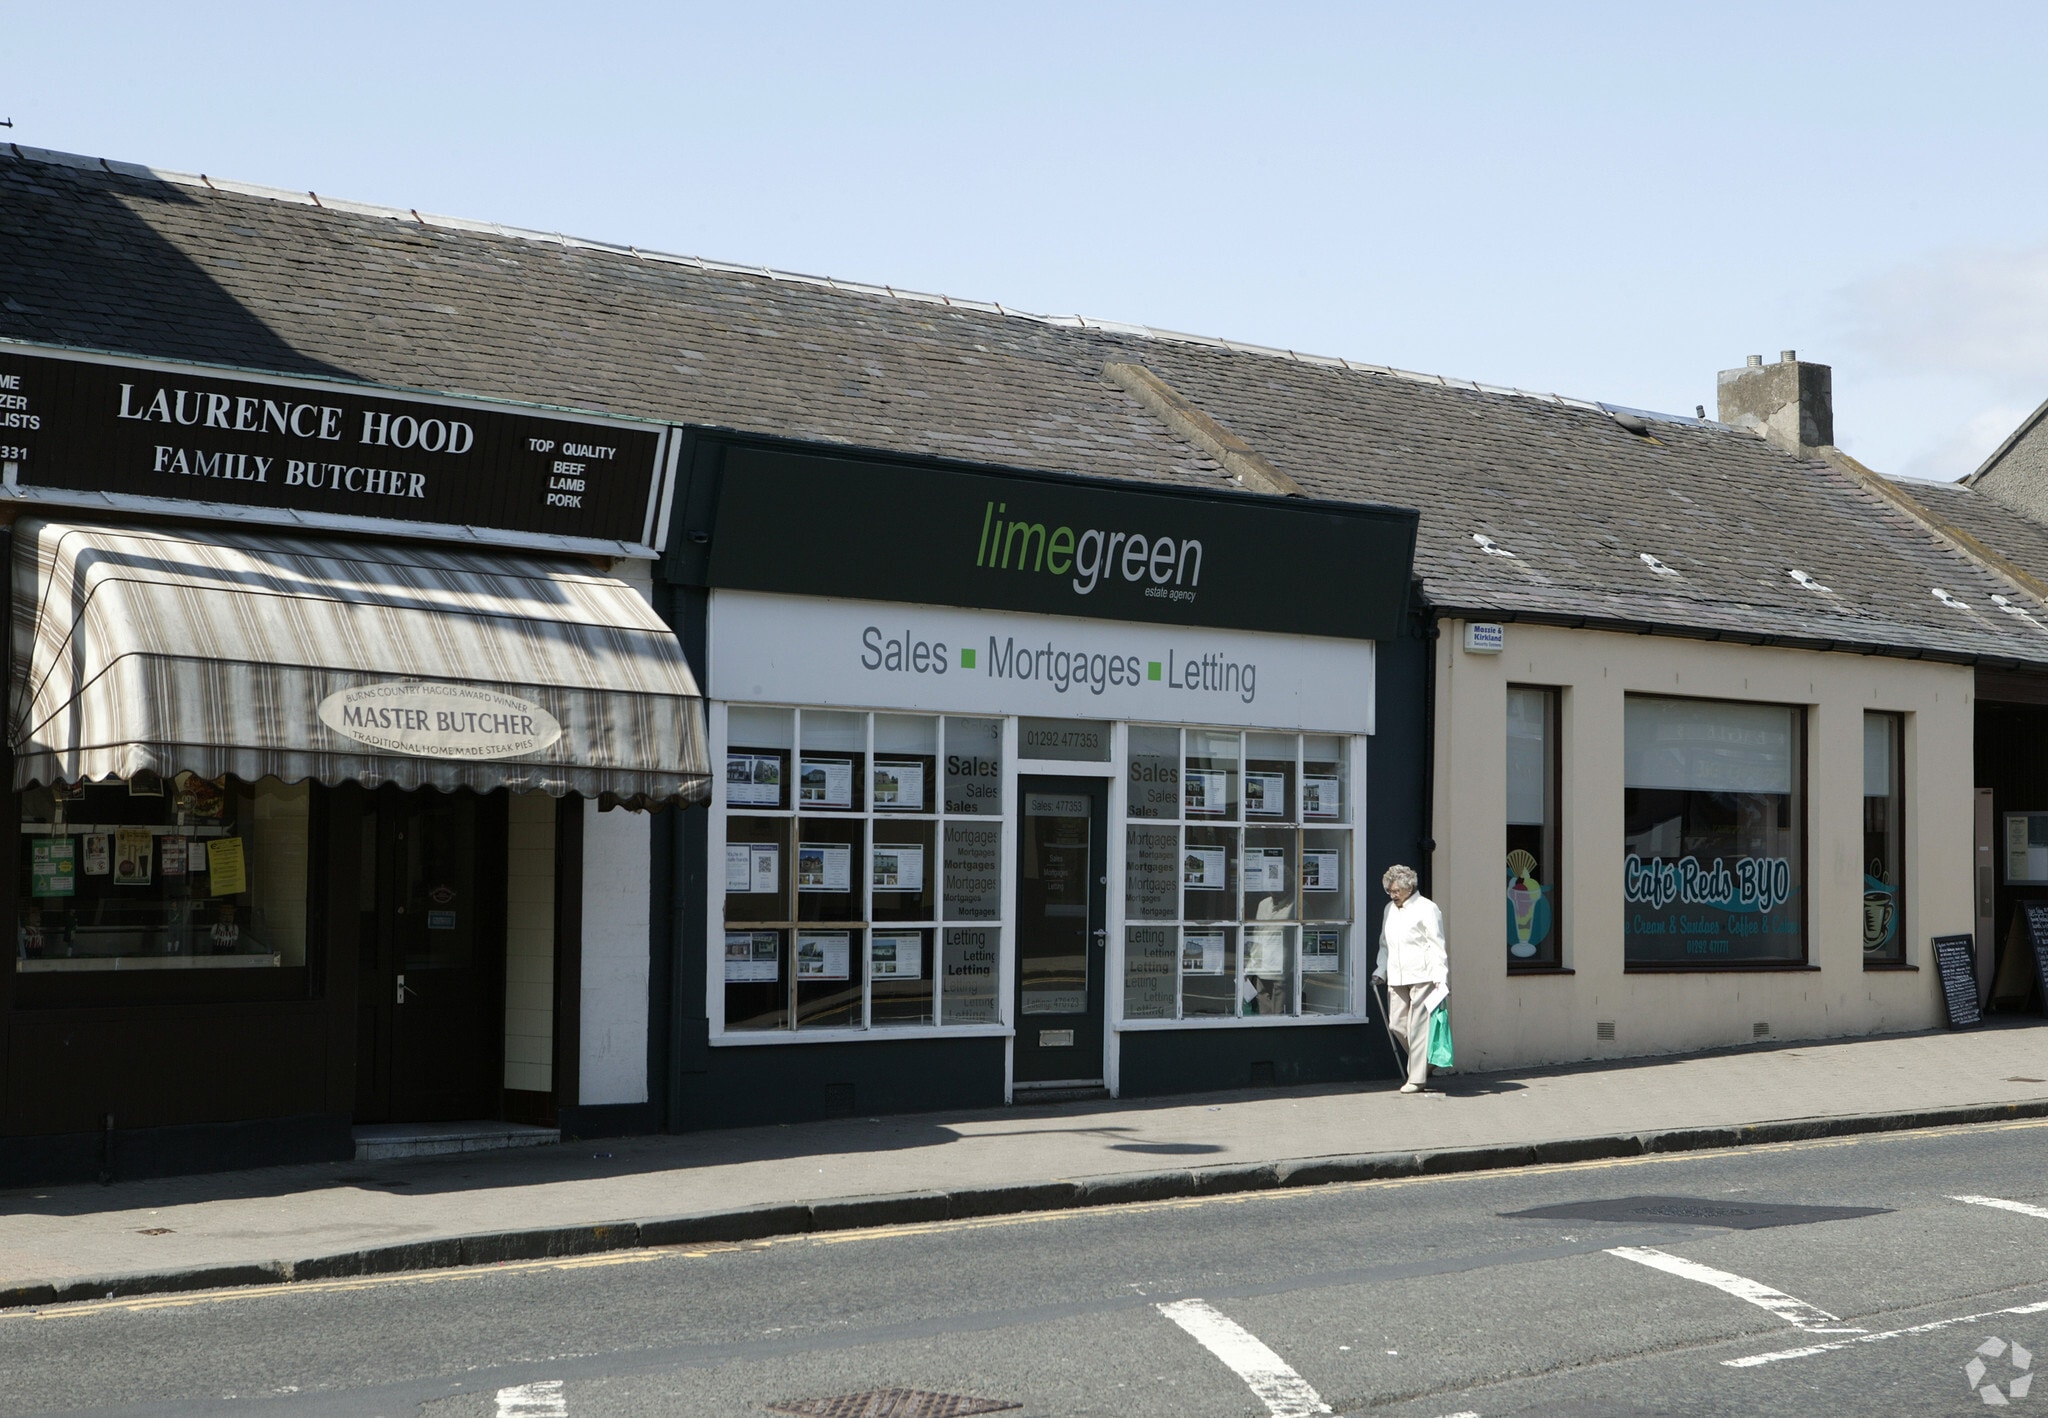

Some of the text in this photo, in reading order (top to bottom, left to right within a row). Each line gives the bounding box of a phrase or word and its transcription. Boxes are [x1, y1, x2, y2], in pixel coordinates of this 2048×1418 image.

[117, 383, 474, 454] LAURENCE HOOD
[528, 438, 616, 460] TOP QUALITY
[153, 445, 427, 498] FAMILY BUTCHER
[553, 460, 586, 476] BEEF
[549, 476, 586, 492] LAMB
[546, 493, 583, 508] PORK
[976, 501, 1203, 595] limegreen
[1144, 586, 1196, 603] estate agency
[861, 626, 1257, 704] Sales Mortgages Letting
[346, 685, 528, 713] BURNS COUNTRY HAGGIS AWARD WINNER
[343, 705, 535, 736] MASTER BUTCHER
[352, 730, 534, 756] TRADITIONAL HOME MADE STEAK PIES
[1027, 730, 1098, 748] 01292 477353
[948, 755, 998, 777] Sales
[1131, 761, 1178, 783] Sales
[966, 783, 997, 798] Sales
[1147, 788, 1178, 803] Sales
[945, 800, 978, 812] Sales
[1055, 800, 1082, 812] 477353
[1128, 804, 1158, 817] Sales
[1127, 831, 1177, 849] Mortgages
[958, 847, 995, 858] Mortgages
[1139, 850, 1174, 860] Mortgages
[944, 859, 995, 871] Mortgages
[1126, 861, 1174, 873] Mortgages
[1128, 876, 1177, 894] Mortgages
[1625, 853, 1790, 913] Café Reds BYO
[944, 893, 981, 903] Mortgages
[958, 906, 995, 917] Mortgages
[1140, 907, 1174, 917] Mortgages
[1633, 913, 1666, 935] Cream
[1669, 914, 1676, 934] &
[1727, 914, 1759, 937] Coffee
[1761, 914, 1768, 934] &
[946, 928, 985, 949] Letting
[1128, 927, 1165, 947] Letting
[1144, 948, 1176, 960] Letting
[1687, 939, 1707, 954] 01292
[948, 964, 990, 977] Letting
[1130, 960, 1169, 974] Letting
[944, 977, 977, 995] Letting
[1126, 974, 1157, 991] Letting
[1144, 991, 1174, 1004] Letting
